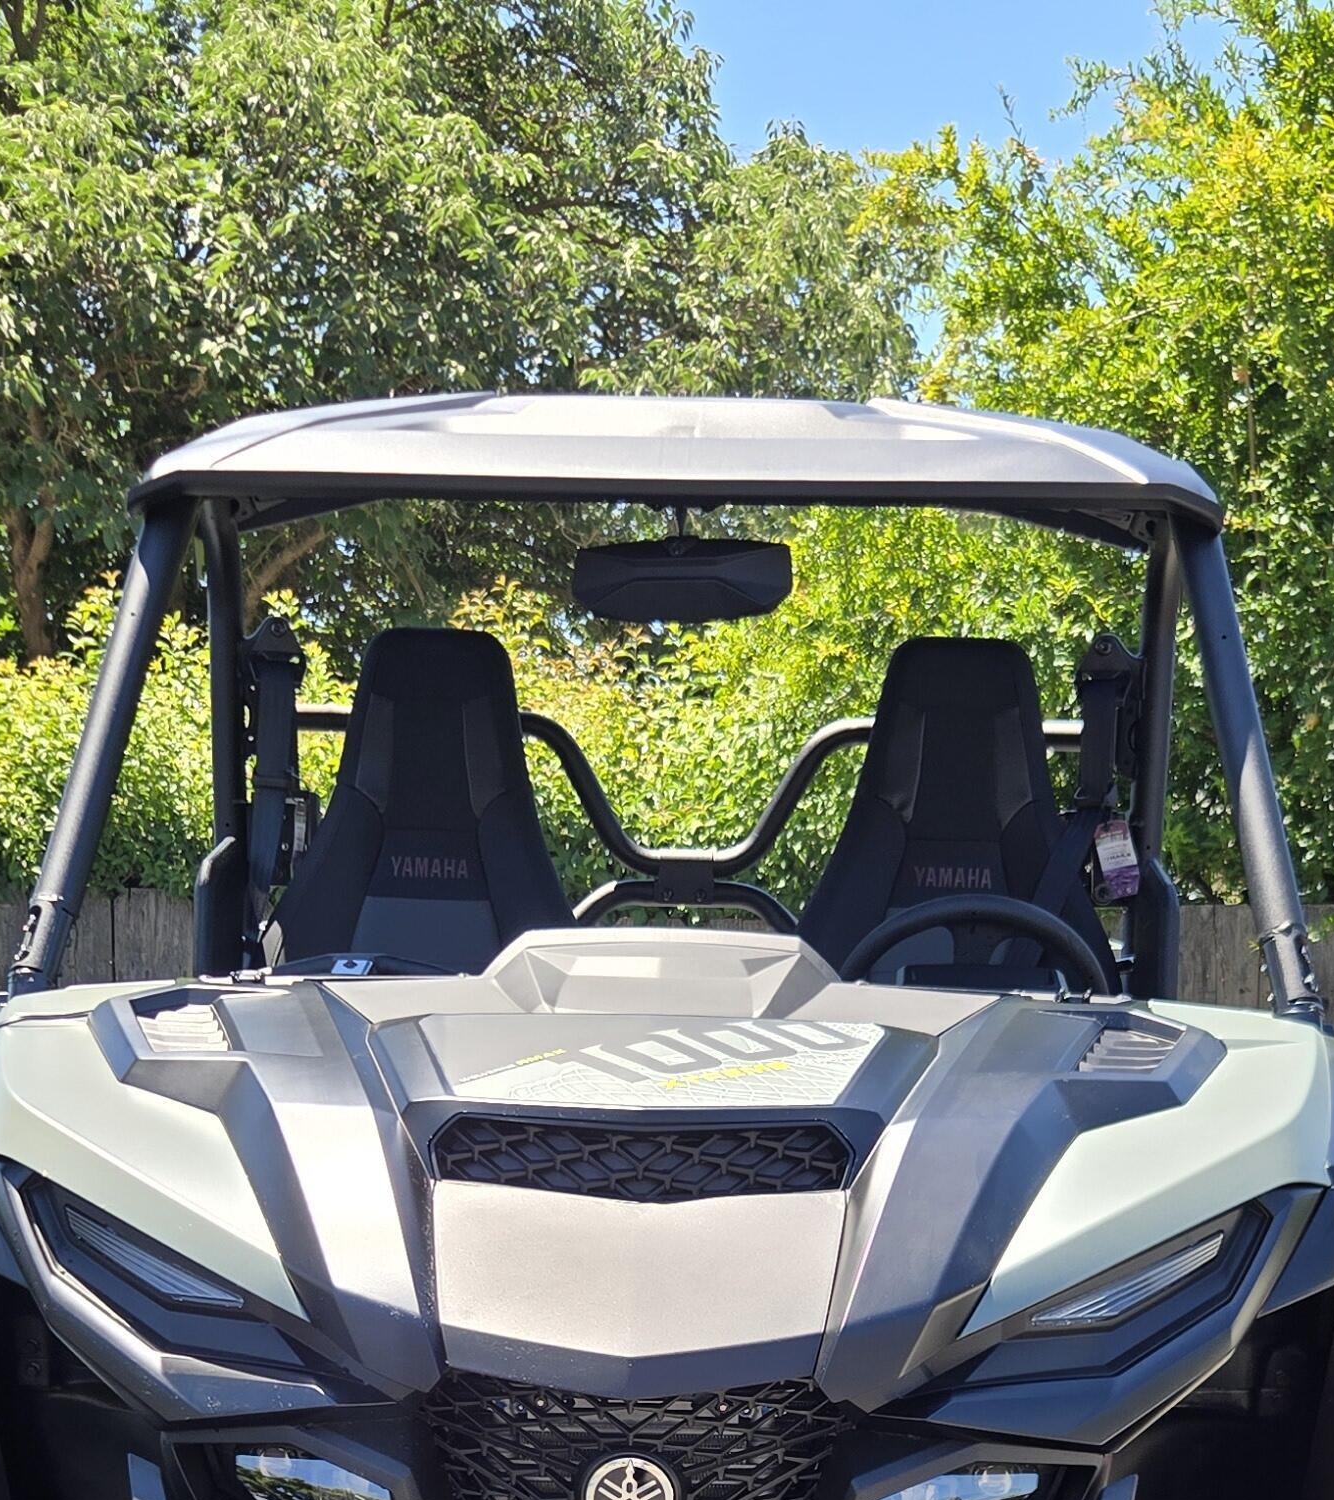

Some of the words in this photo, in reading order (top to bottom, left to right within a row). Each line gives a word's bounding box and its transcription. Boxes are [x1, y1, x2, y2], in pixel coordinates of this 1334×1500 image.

[391, 855, 468, 879] YAMAHA
[913, 865, 992, 889] YAMAHA
[543, 1017, 870, 1084] 1000
